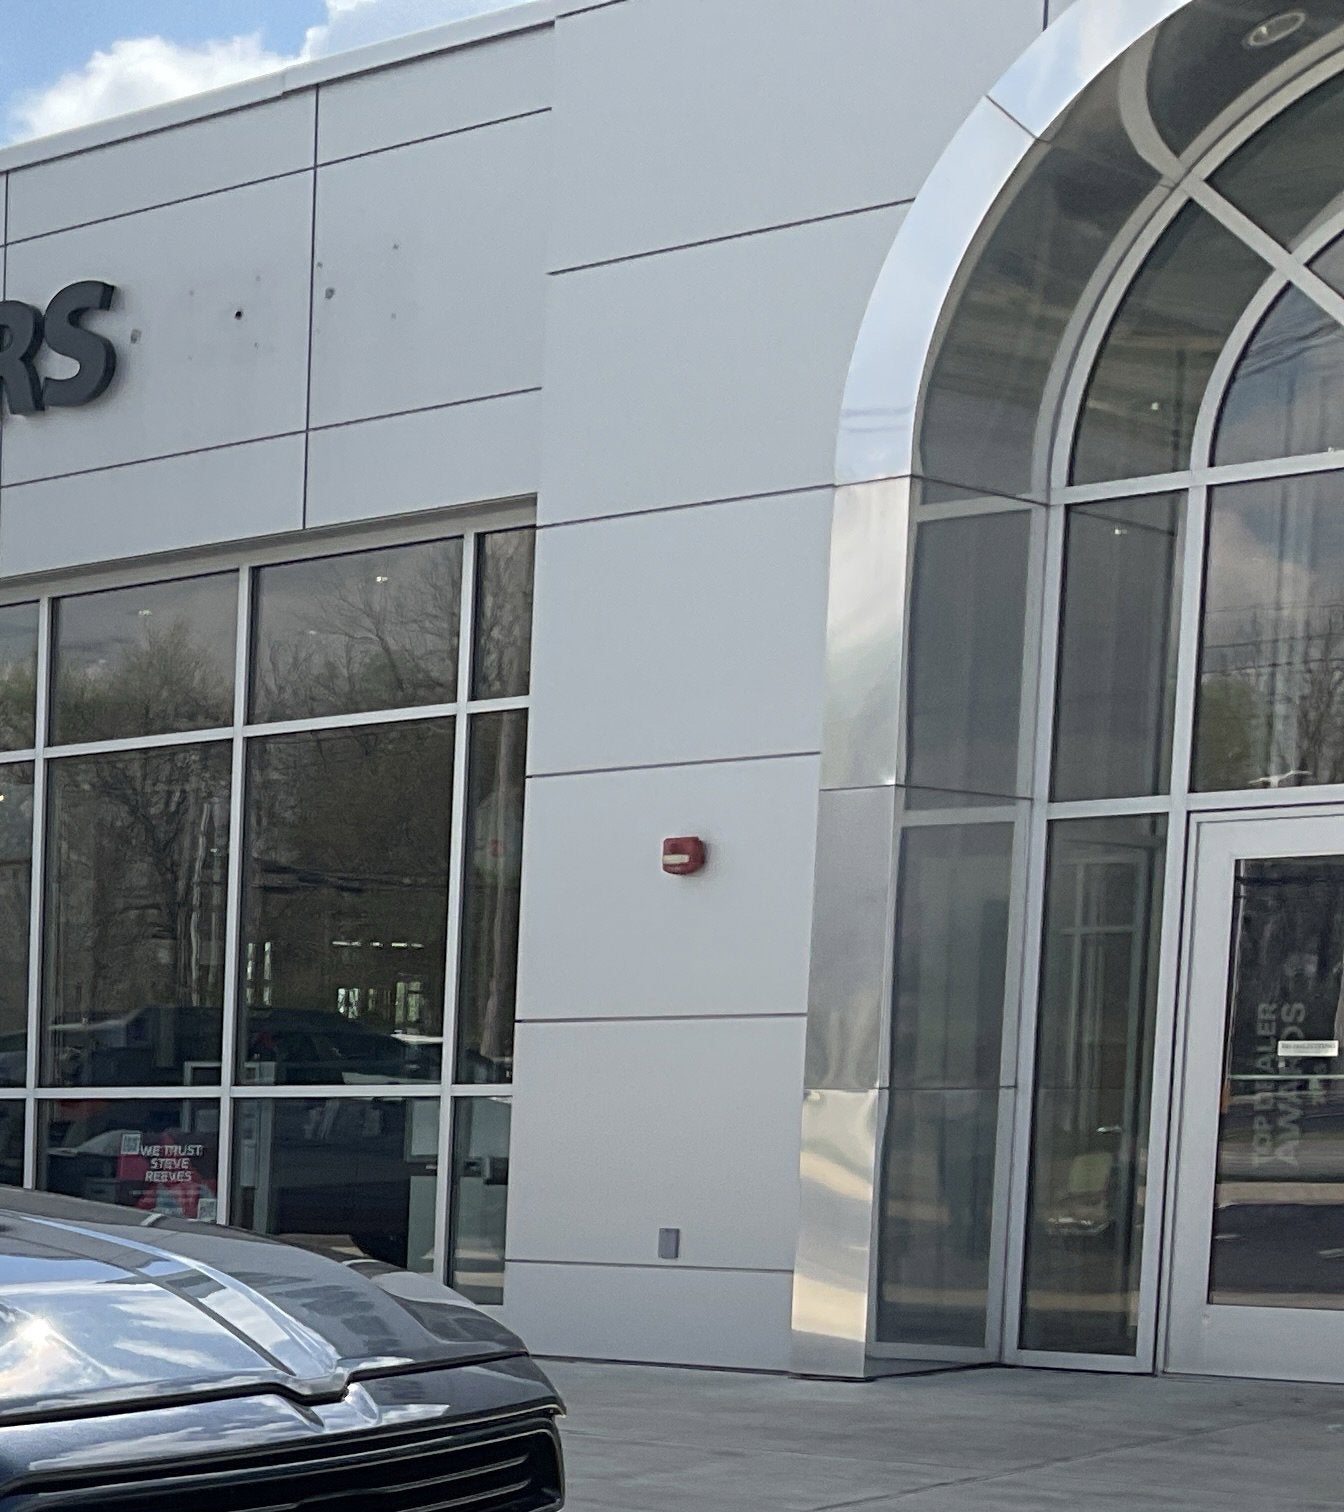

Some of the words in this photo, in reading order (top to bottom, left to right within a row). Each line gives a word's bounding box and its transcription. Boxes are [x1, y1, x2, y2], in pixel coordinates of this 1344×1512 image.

[140, 1145, 160, 1157] WE
[164, 1144, 203, 1157] TRUST
[150, 1157, 190, 1169] STEVE
[145, 1170, 192, 1182] REEVES
